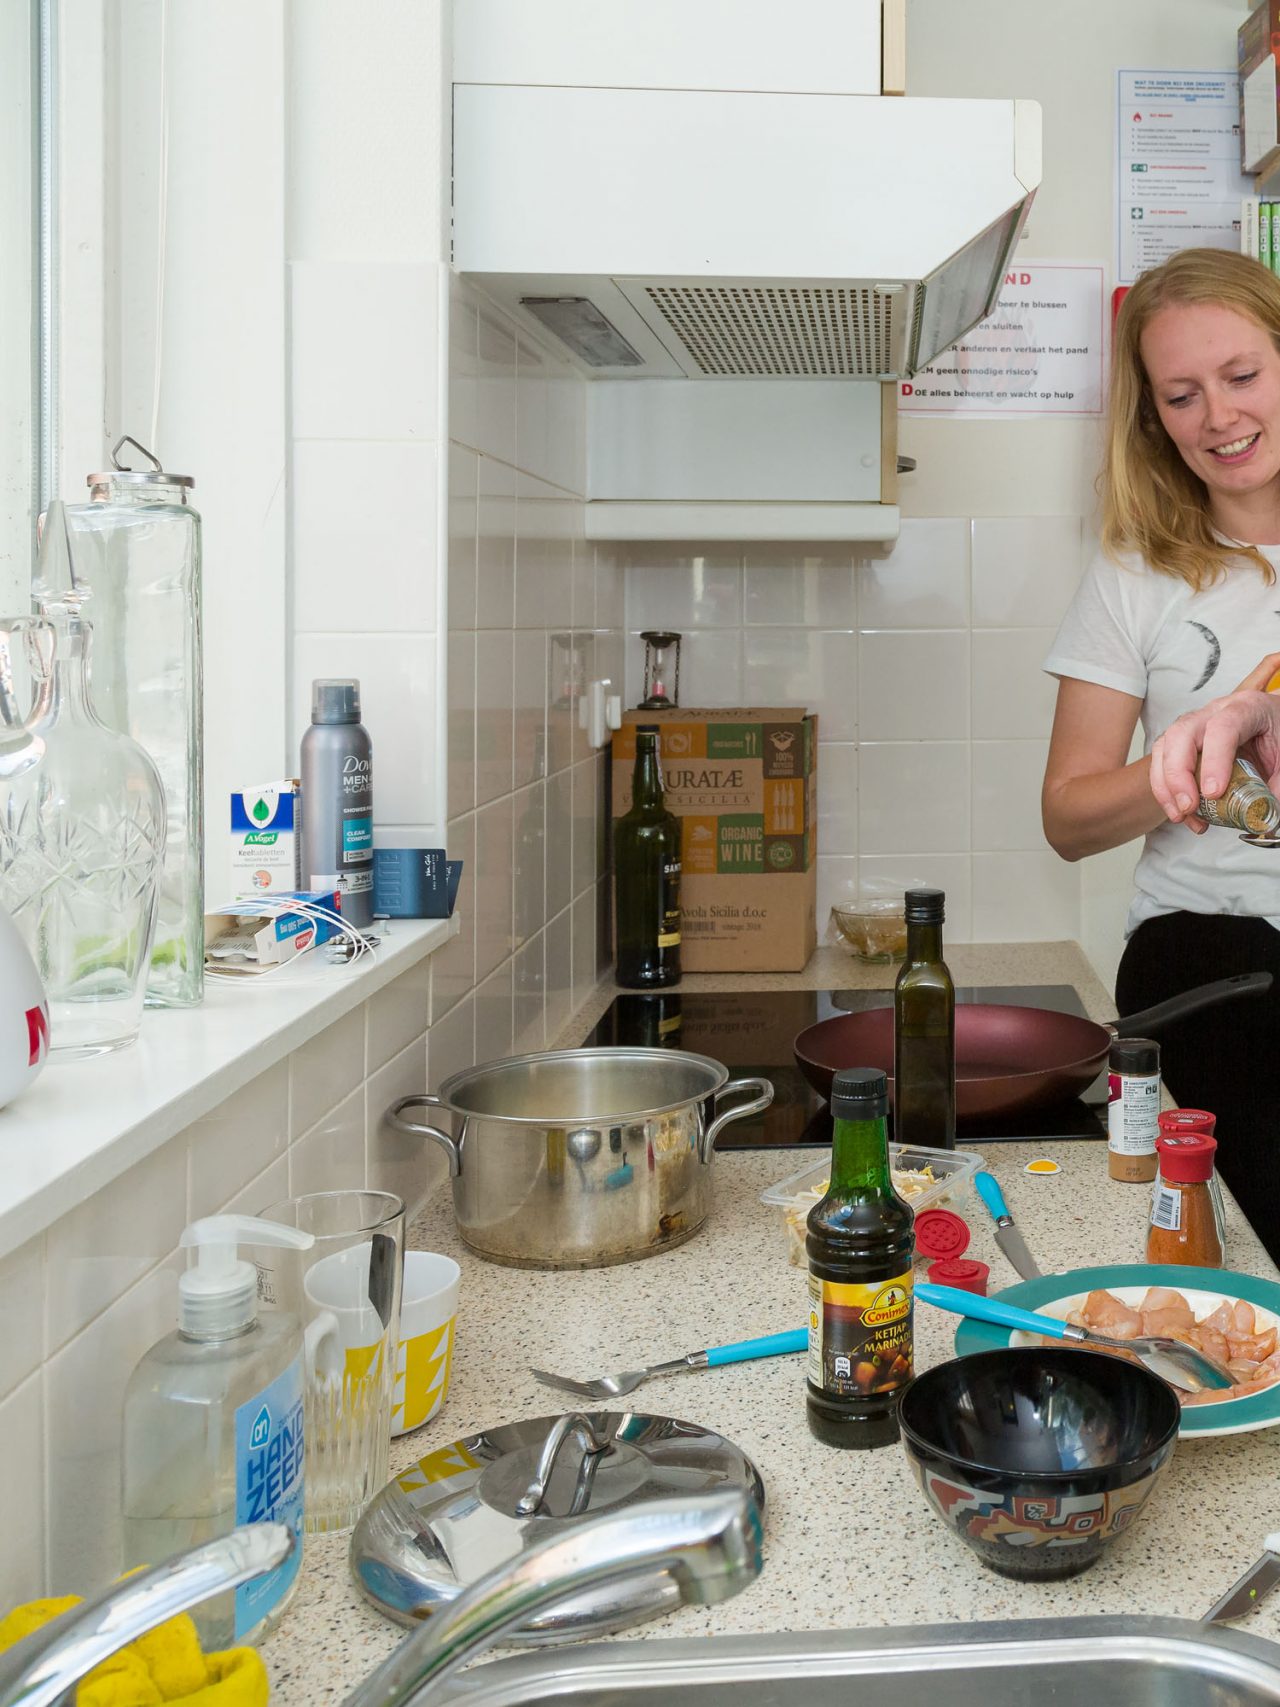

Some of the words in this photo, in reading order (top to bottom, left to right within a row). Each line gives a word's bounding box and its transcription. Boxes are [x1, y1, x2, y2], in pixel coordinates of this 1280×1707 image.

[997, 300, 1018, 309] beer
[1021, 301, 1030, 309] te
[1032, 301, 1068, 309] blussen
[992, 322, 1024, 331] sluiten
[960, 345, 998, 353] anderen
[1014, 346, 1046, 354] verlaat
[1048, 346, 1064, 354] het
[1066, 347, 1089, 355] pand
[936, 368, 959, 376] geen
[961, 367, 1004, 376] onnodige
[1005, 367, 1038, 376] risico's
[1054, 391, 1075, 399] hulp
[342, 755, 372, 774] Dov
[665, 770, 744, 793] URATÆ
[678, 795, 751, 805] SICILIA
[346, 829, 366, 837] CLEAN
[721, 826, 763, 841] ORGANIC
[238, 848, 286, 857] Keeltabletten
[720, 843, 764, 862] WINE
[709, 905, 740, 918] Sicilia
[867, 1303, 909, 1323] Conimex
[875, 1322, 908, 1340] KETJAP
[247, 1404, 304, 1490] HAND
[246, 1434, 304, 1524] ZEEP
